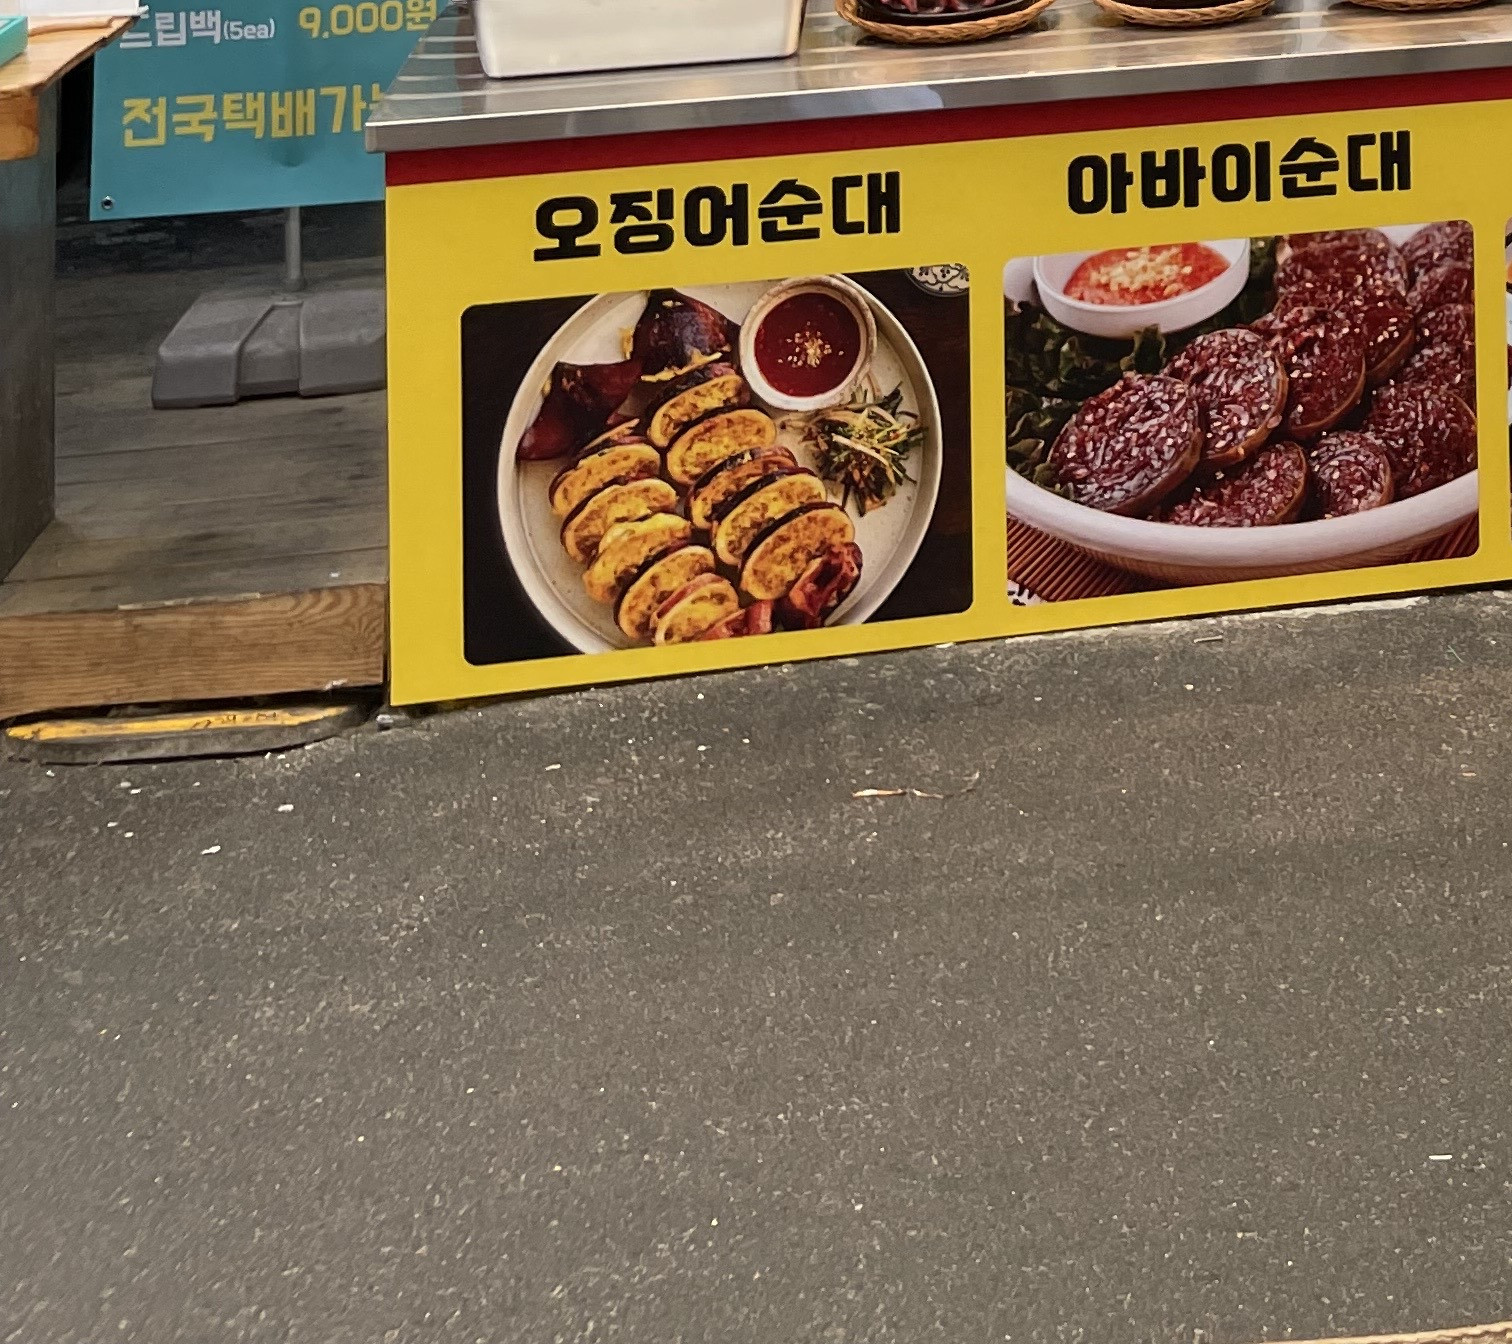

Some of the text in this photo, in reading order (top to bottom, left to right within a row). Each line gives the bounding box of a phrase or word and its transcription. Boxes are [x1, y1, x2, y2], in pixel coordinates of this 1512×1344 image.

[122, 82, 386, 149] 전국택배가
[533, 170, 901, 262] 오징어순대
[1066, 128, 1412, 216] 아바이순대
